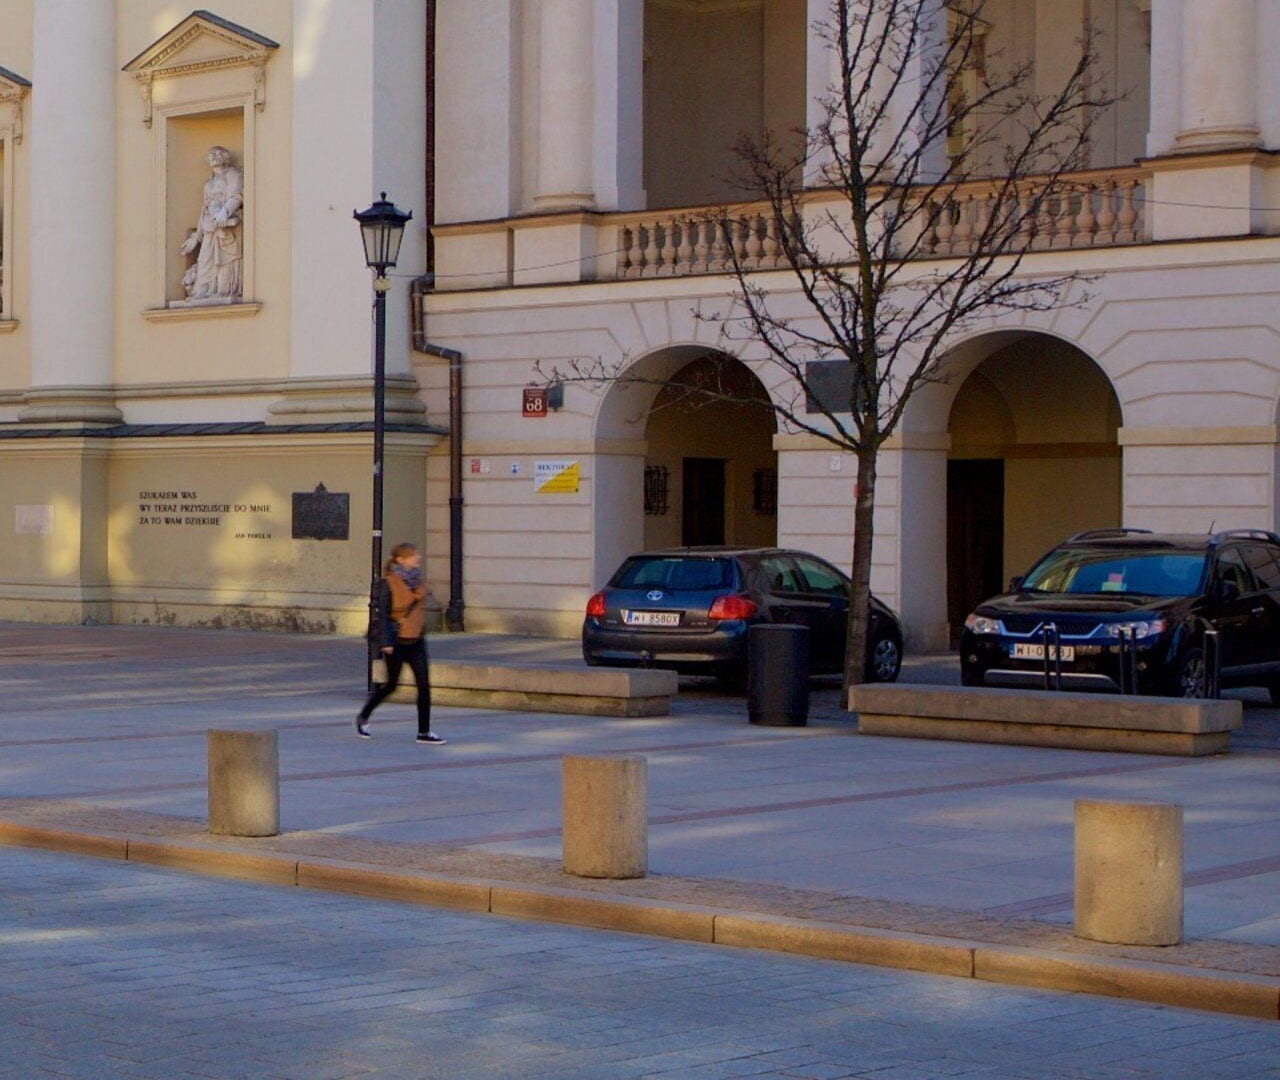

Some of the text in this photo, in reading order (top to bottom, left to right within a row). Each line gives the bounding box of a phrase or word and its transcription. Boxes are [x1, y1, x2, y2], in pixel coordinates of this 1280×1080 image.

[526, 397, 542, 412] 68
[181, 491, 197, 500] WAS
[154, 504, 177, 513] TERAZ
[234, 504, 248, 513] DO
[250, 504, 272, 513] MNIE
[139, 517, 149, 525] ZA
[151, 517, 162, 525] TO
[164, 517, 182, 525] WAM
